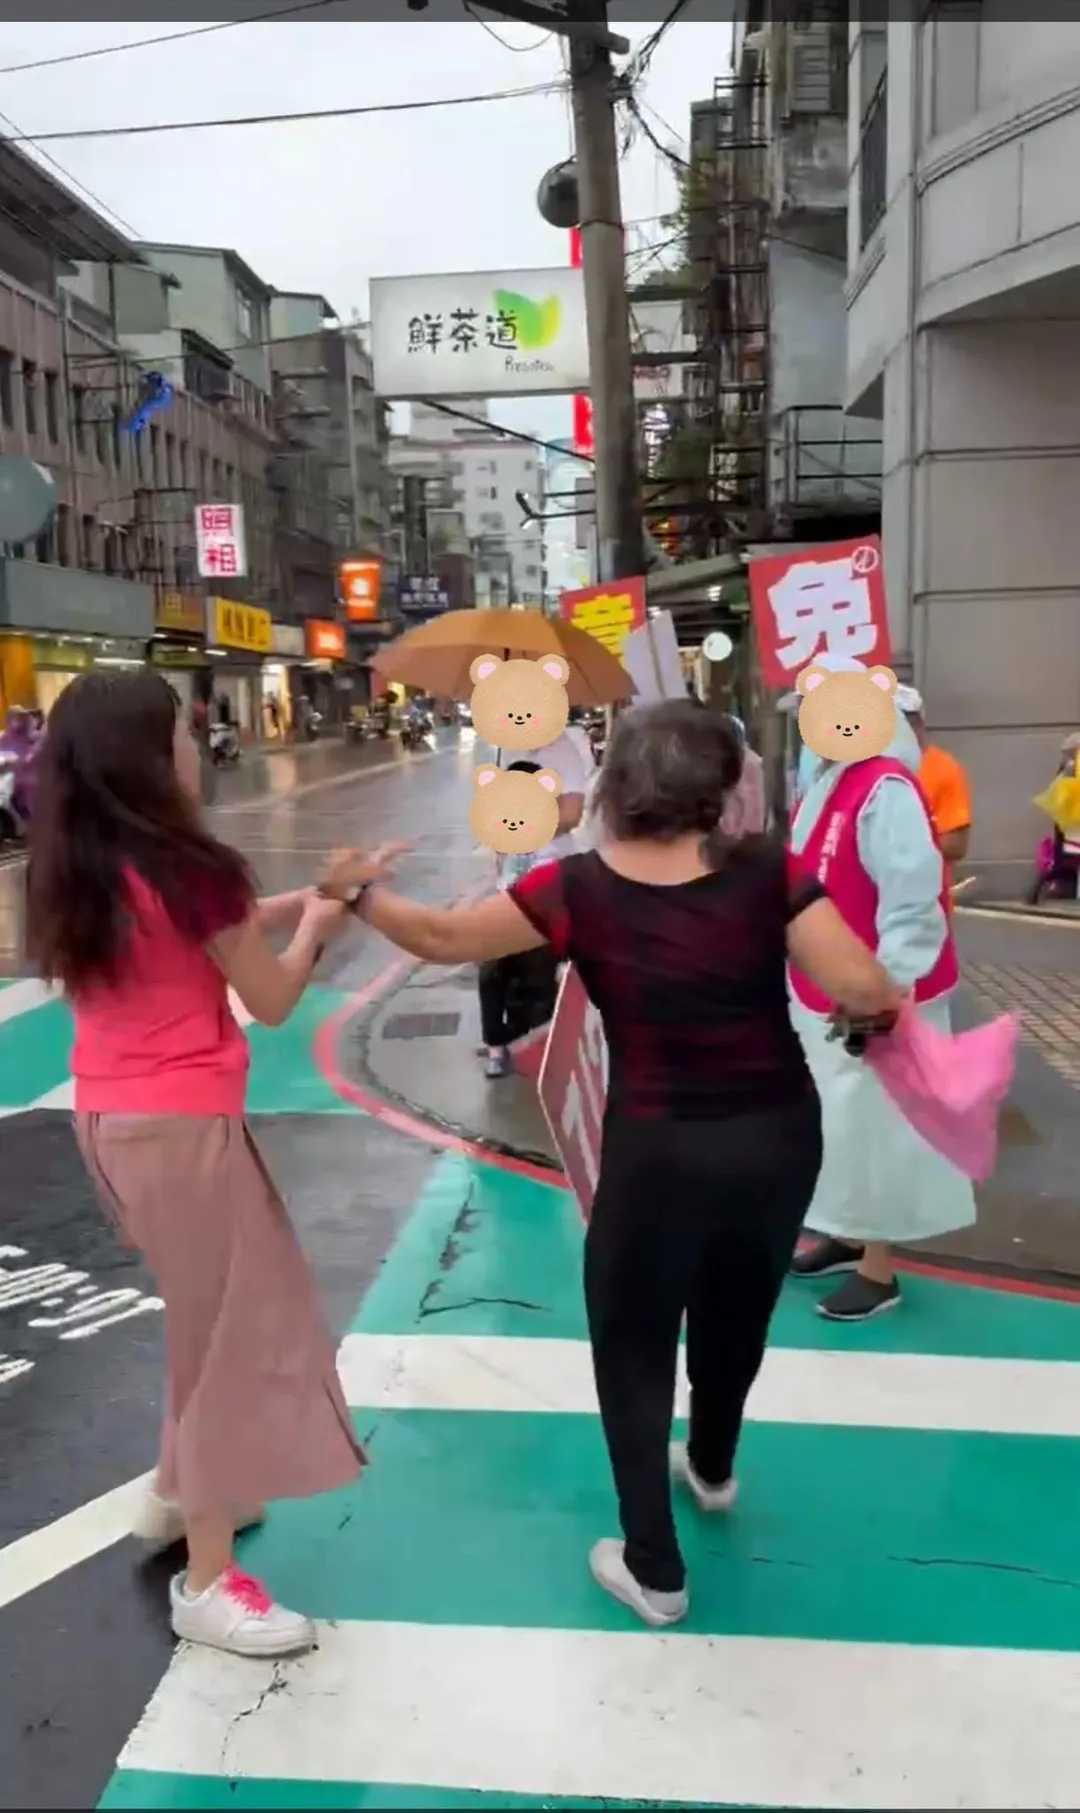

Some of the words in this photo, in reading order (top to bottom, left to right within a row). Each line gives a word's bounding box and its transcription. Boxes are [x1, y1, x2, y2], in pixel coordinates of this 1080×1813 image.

[408, 308, 518, 353] 鮮茶道
[201, 507, 237, 572] 照相
[767, 557, 878, 670] 免
